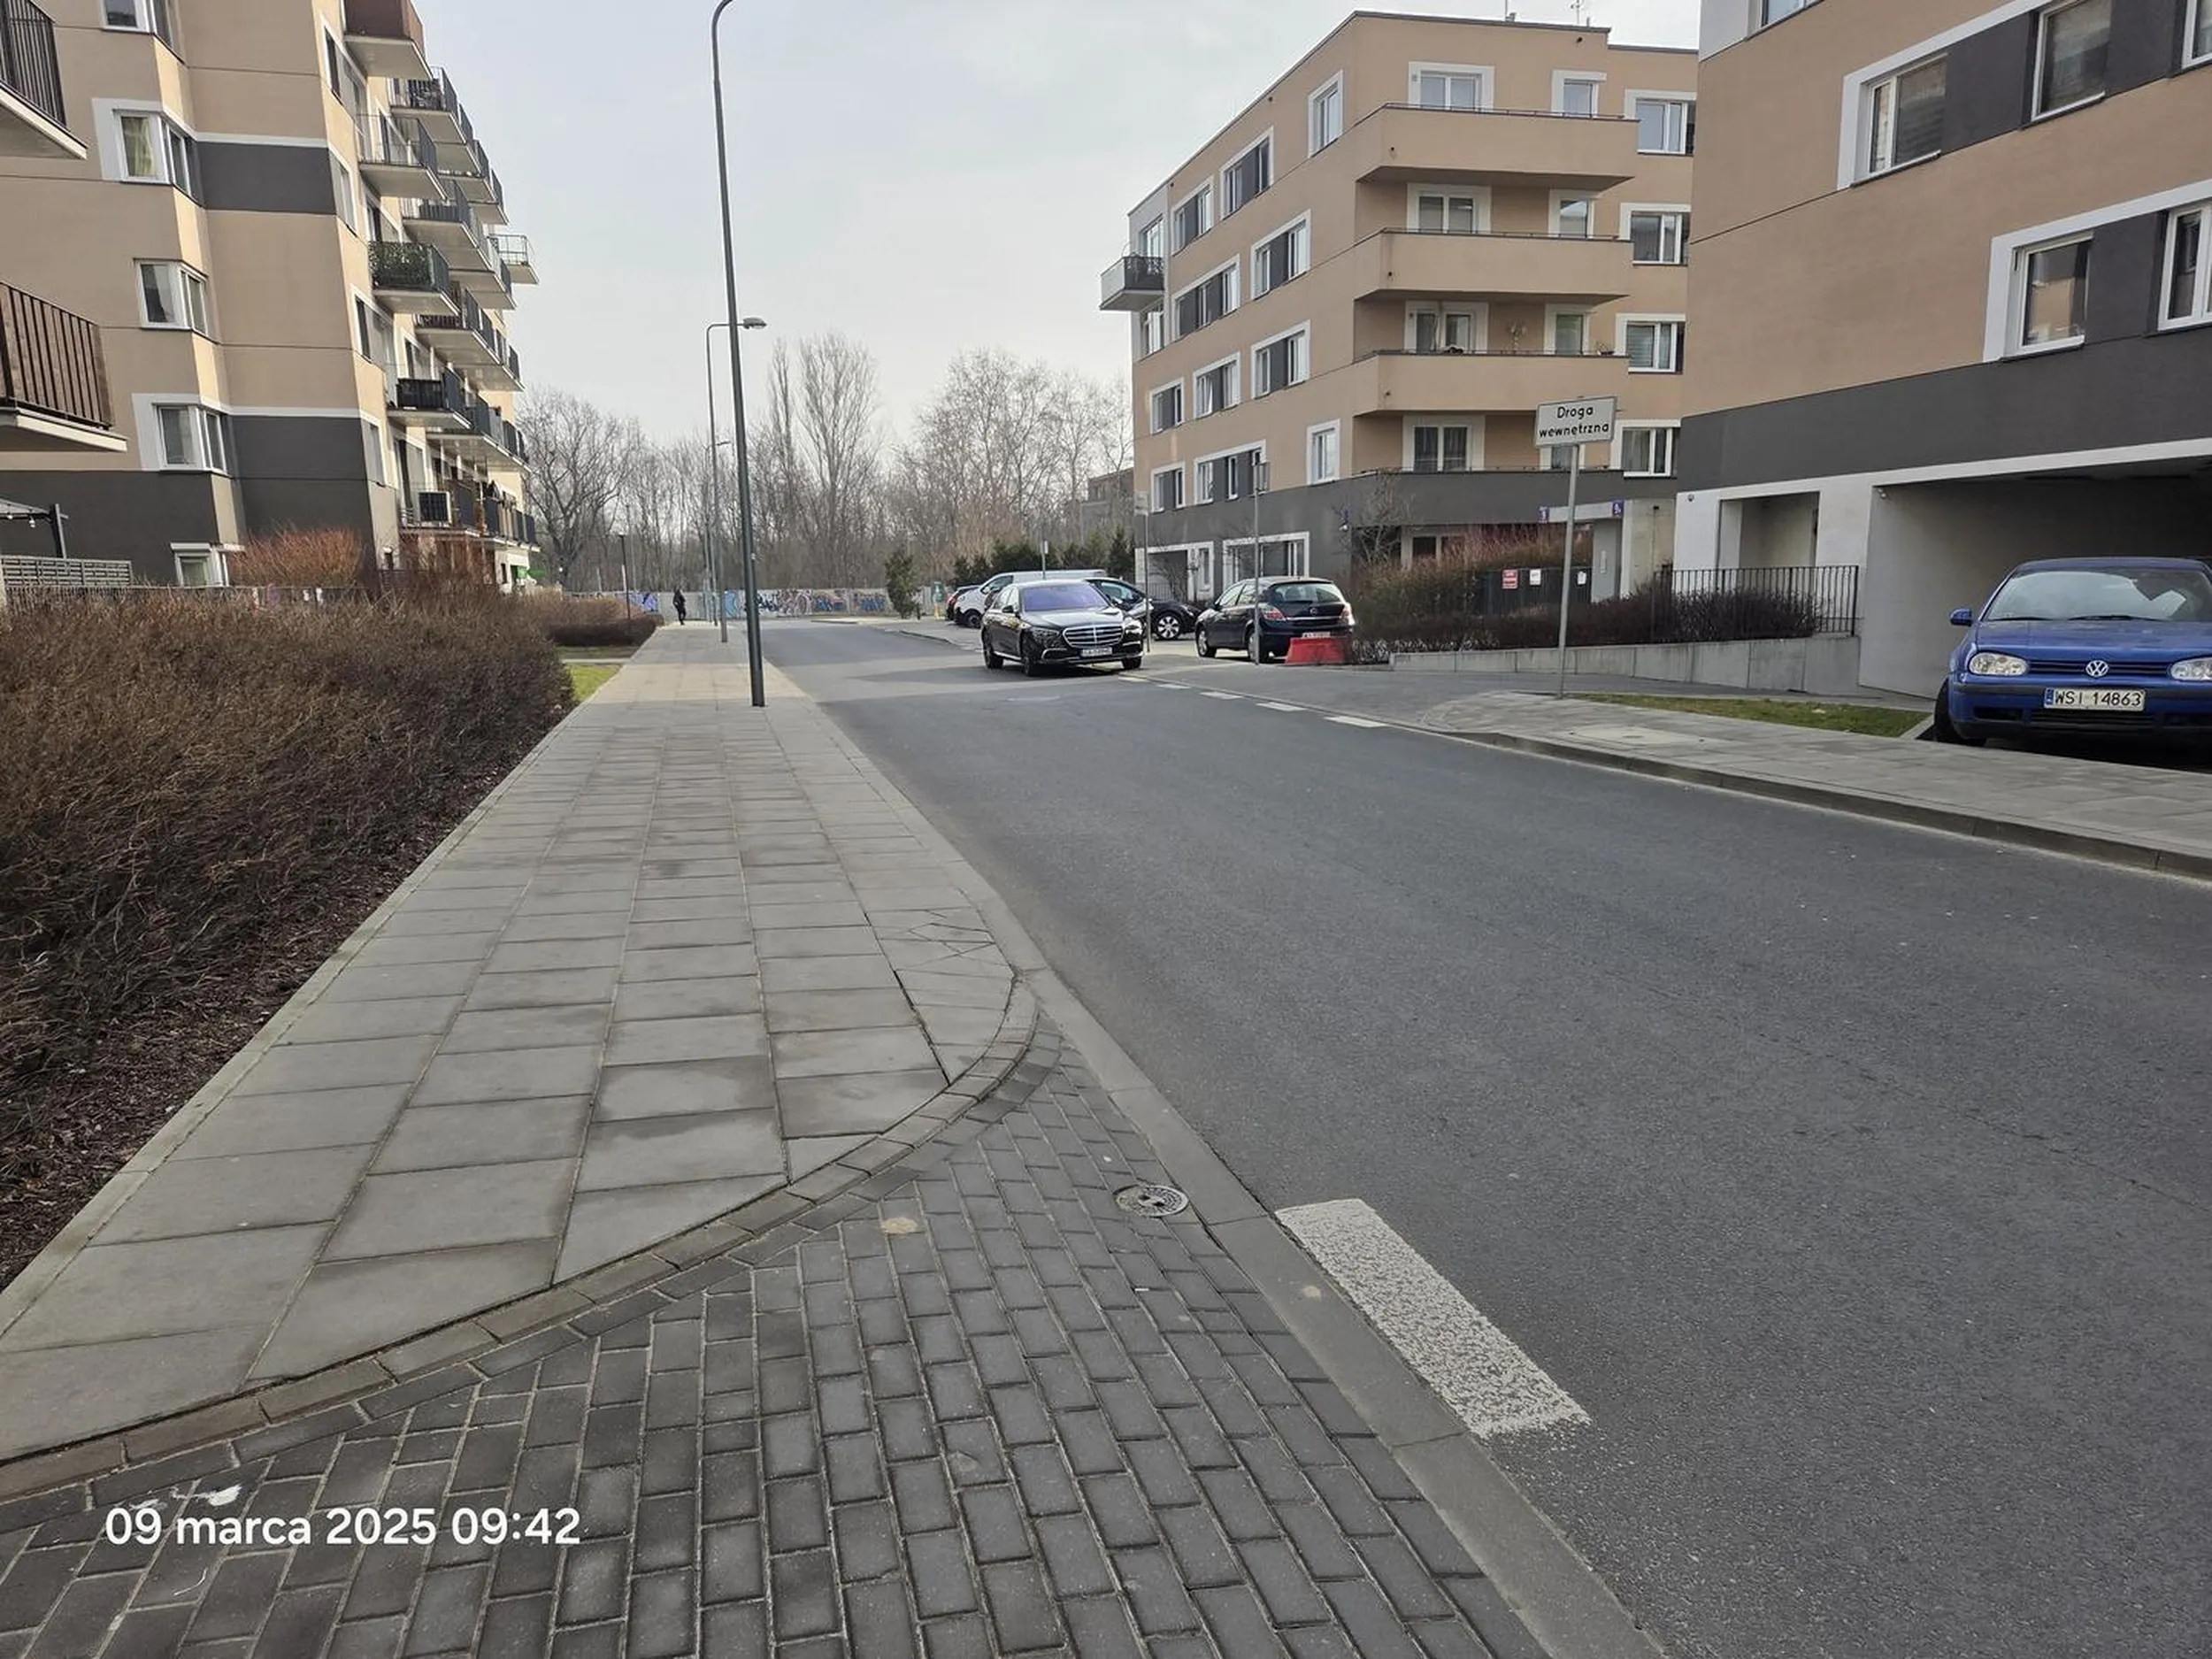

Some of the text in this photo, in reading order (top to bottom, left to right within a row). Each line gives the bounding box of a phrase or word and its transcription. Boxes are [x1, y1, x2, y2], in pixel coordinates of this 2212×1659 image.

[1557, 406, 1594, 419] Droga
[2055, 690, 2141, 706] WSI 14863
